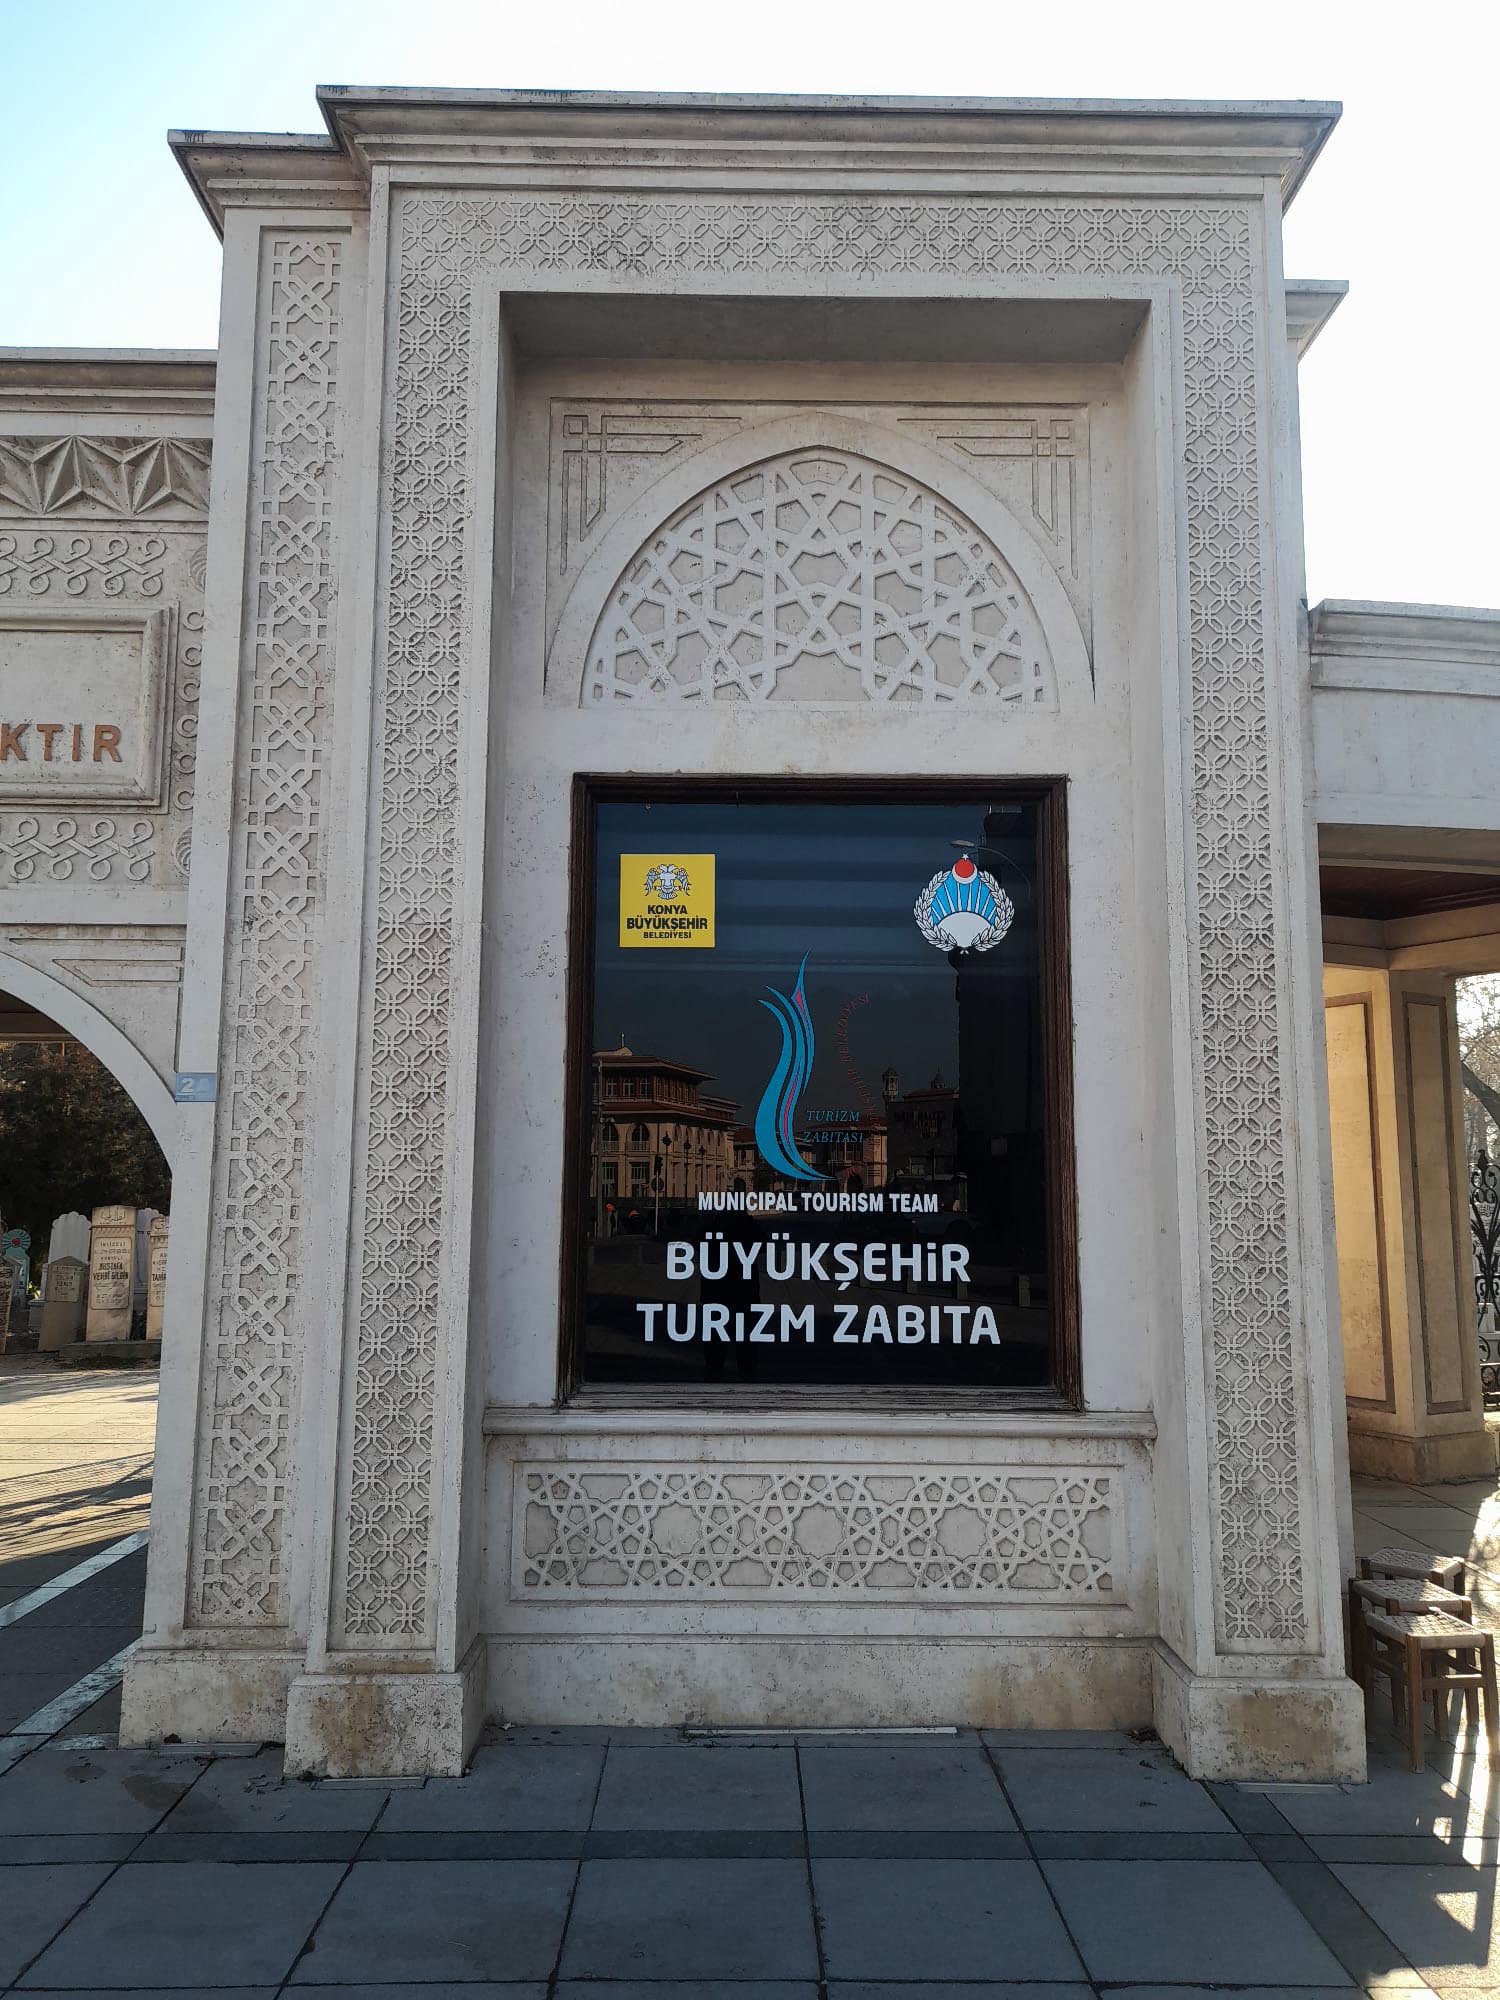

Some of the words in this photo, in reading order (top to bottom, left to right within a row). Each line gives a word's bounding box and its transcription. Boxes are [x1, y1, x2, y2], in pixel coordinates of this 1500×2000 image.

[647, 905, 688, 914] KONYA
[626, 915, 708, 931] BÜYÜKŞEHİR
[643, 931, 692, 939] BELEDİYESİ
[806, 1108, 860, 1122] TURİZM
[803, 1131, 864, 1144] ZABITASI
[698, 1191, 798, 1212] MUNICIPAL
[800, 1191, 884, 1213] TOURISM
[888, 1193, 939, 1213] TEAM
[833, 1304, 1001, 1345] ZABITA
